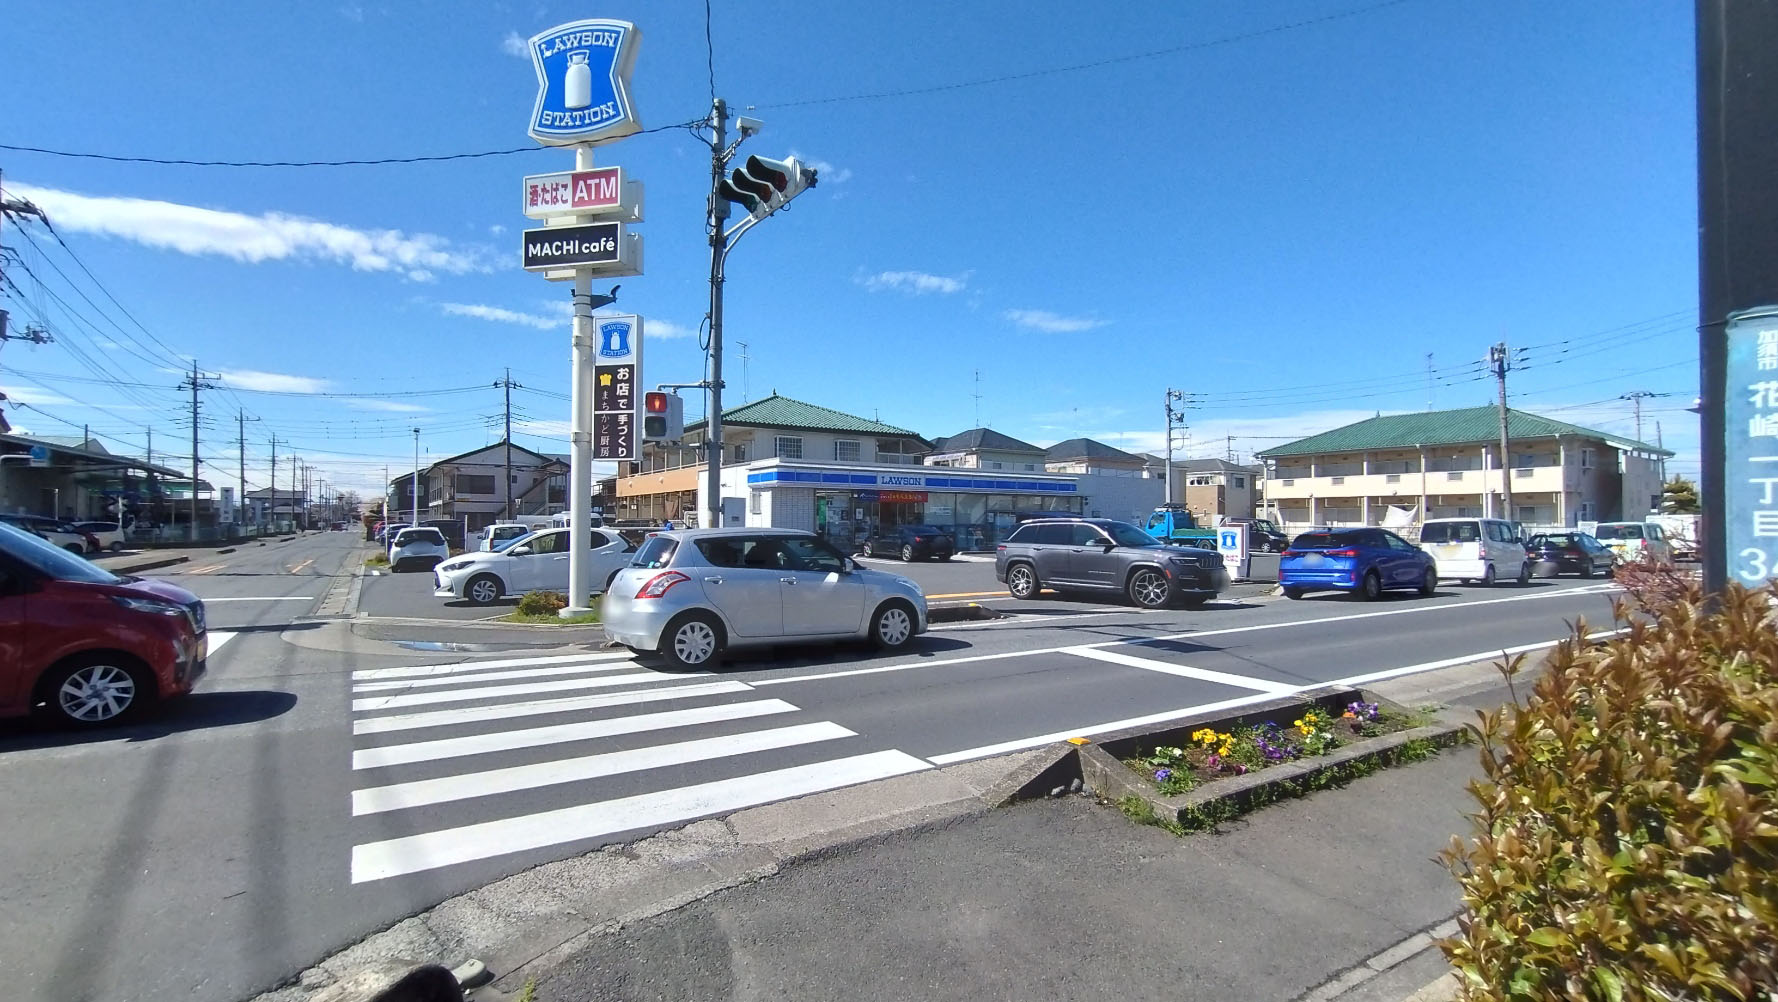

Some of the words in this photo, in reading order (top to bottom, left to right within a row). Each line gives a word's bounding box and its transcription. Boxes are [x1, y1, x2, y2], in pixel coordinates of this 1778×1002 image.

[542, 32, 618, 58] LAWSON
[541, 101, 616, 127] STATION
[574, 176, 616, 202] ATM
[528, 239, 579, 258] MACHI
[581, 237, 615, 254] café
[602, 324, 629, 334] LAWSON
[602, 348, 628, 357] STATION
[1756, 330, 1778, 371] 加須市
[600, 390, 610, 457] まちかど厨房
[881, 476, 922, 486] LAWSON
